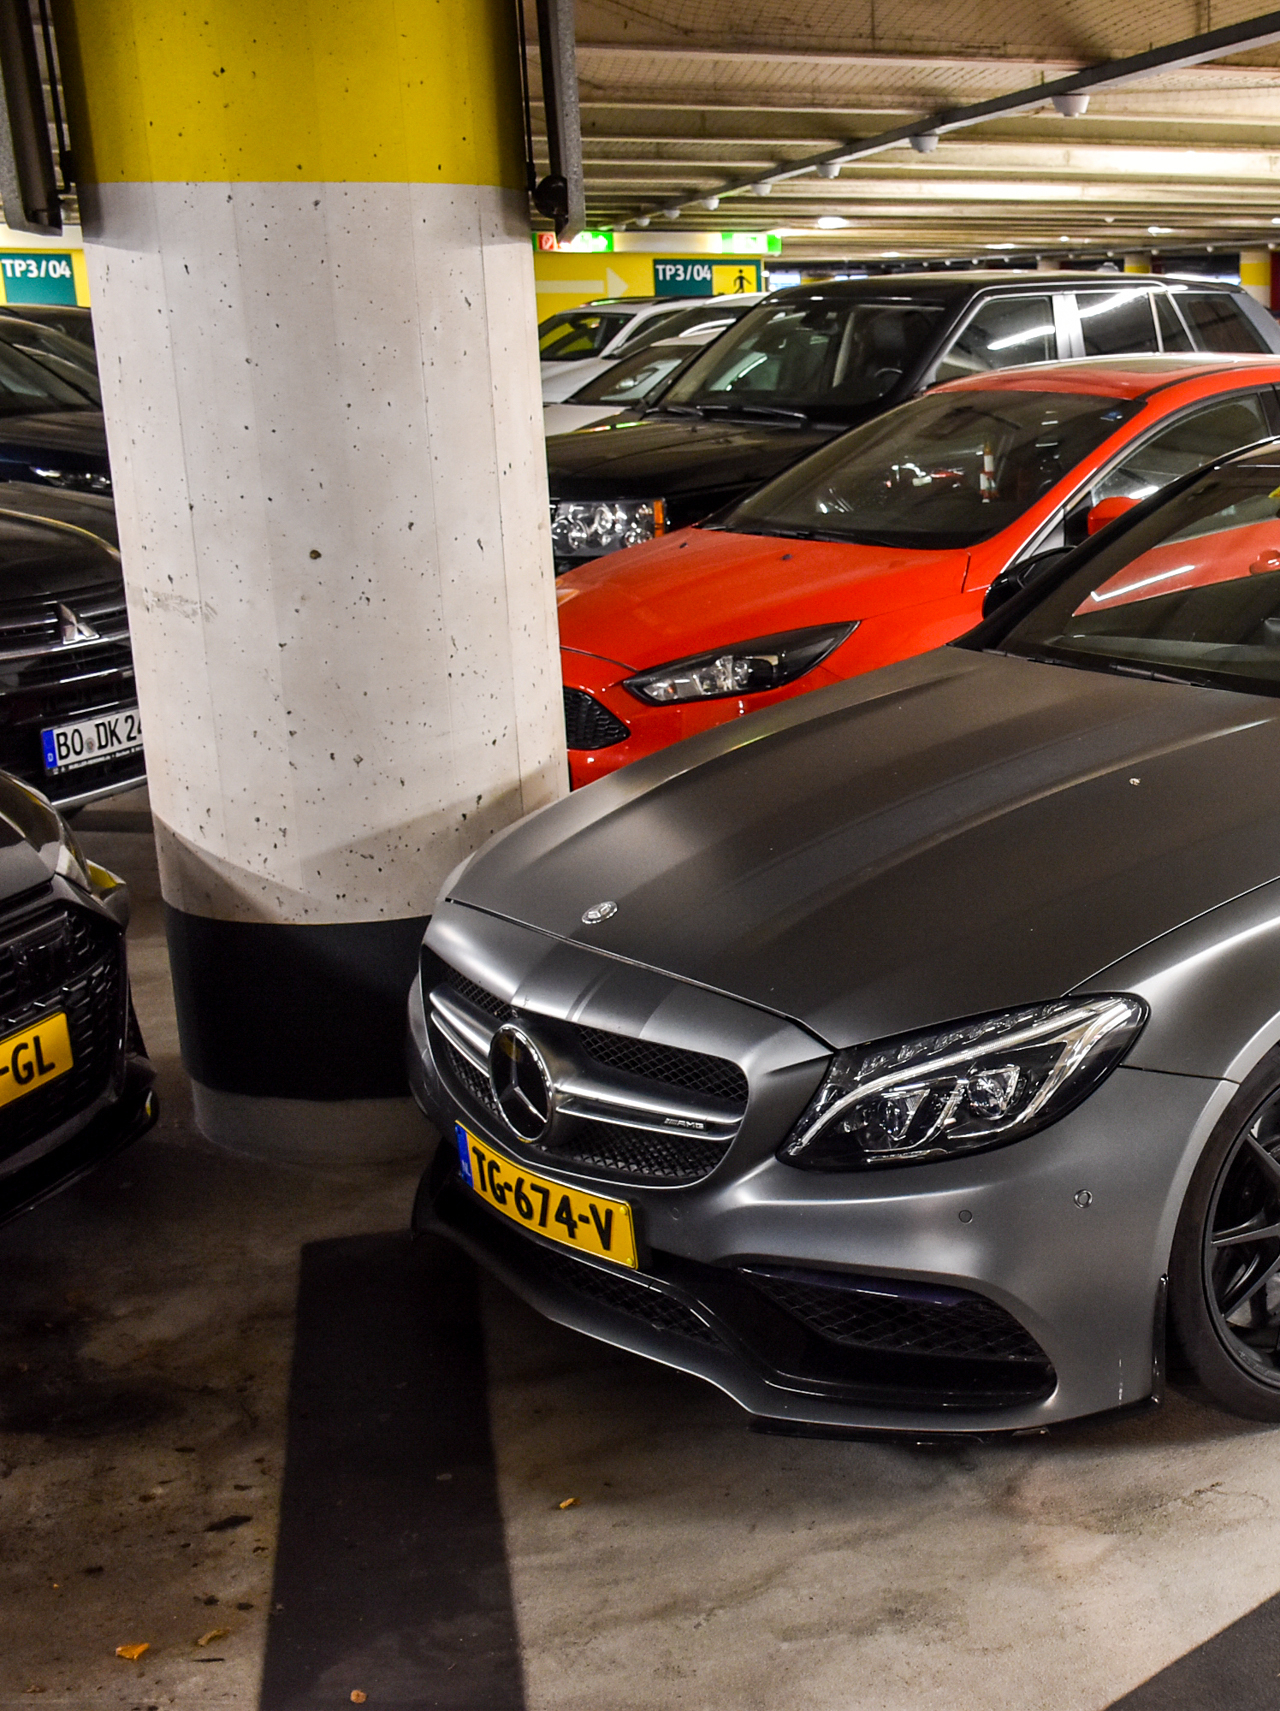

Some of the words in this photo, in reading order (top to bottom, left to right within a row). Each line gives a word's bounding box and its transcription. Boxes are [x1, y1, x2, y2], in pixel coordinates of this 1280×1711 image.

[1, 259, 72, 279] TP3/04
[655, 264, 712, 282] TP3/04
[56, 729, 84, 761] BO
[95, 718, 122, 750] DK
[472, 1146, 613, 1251] TG-674-V
